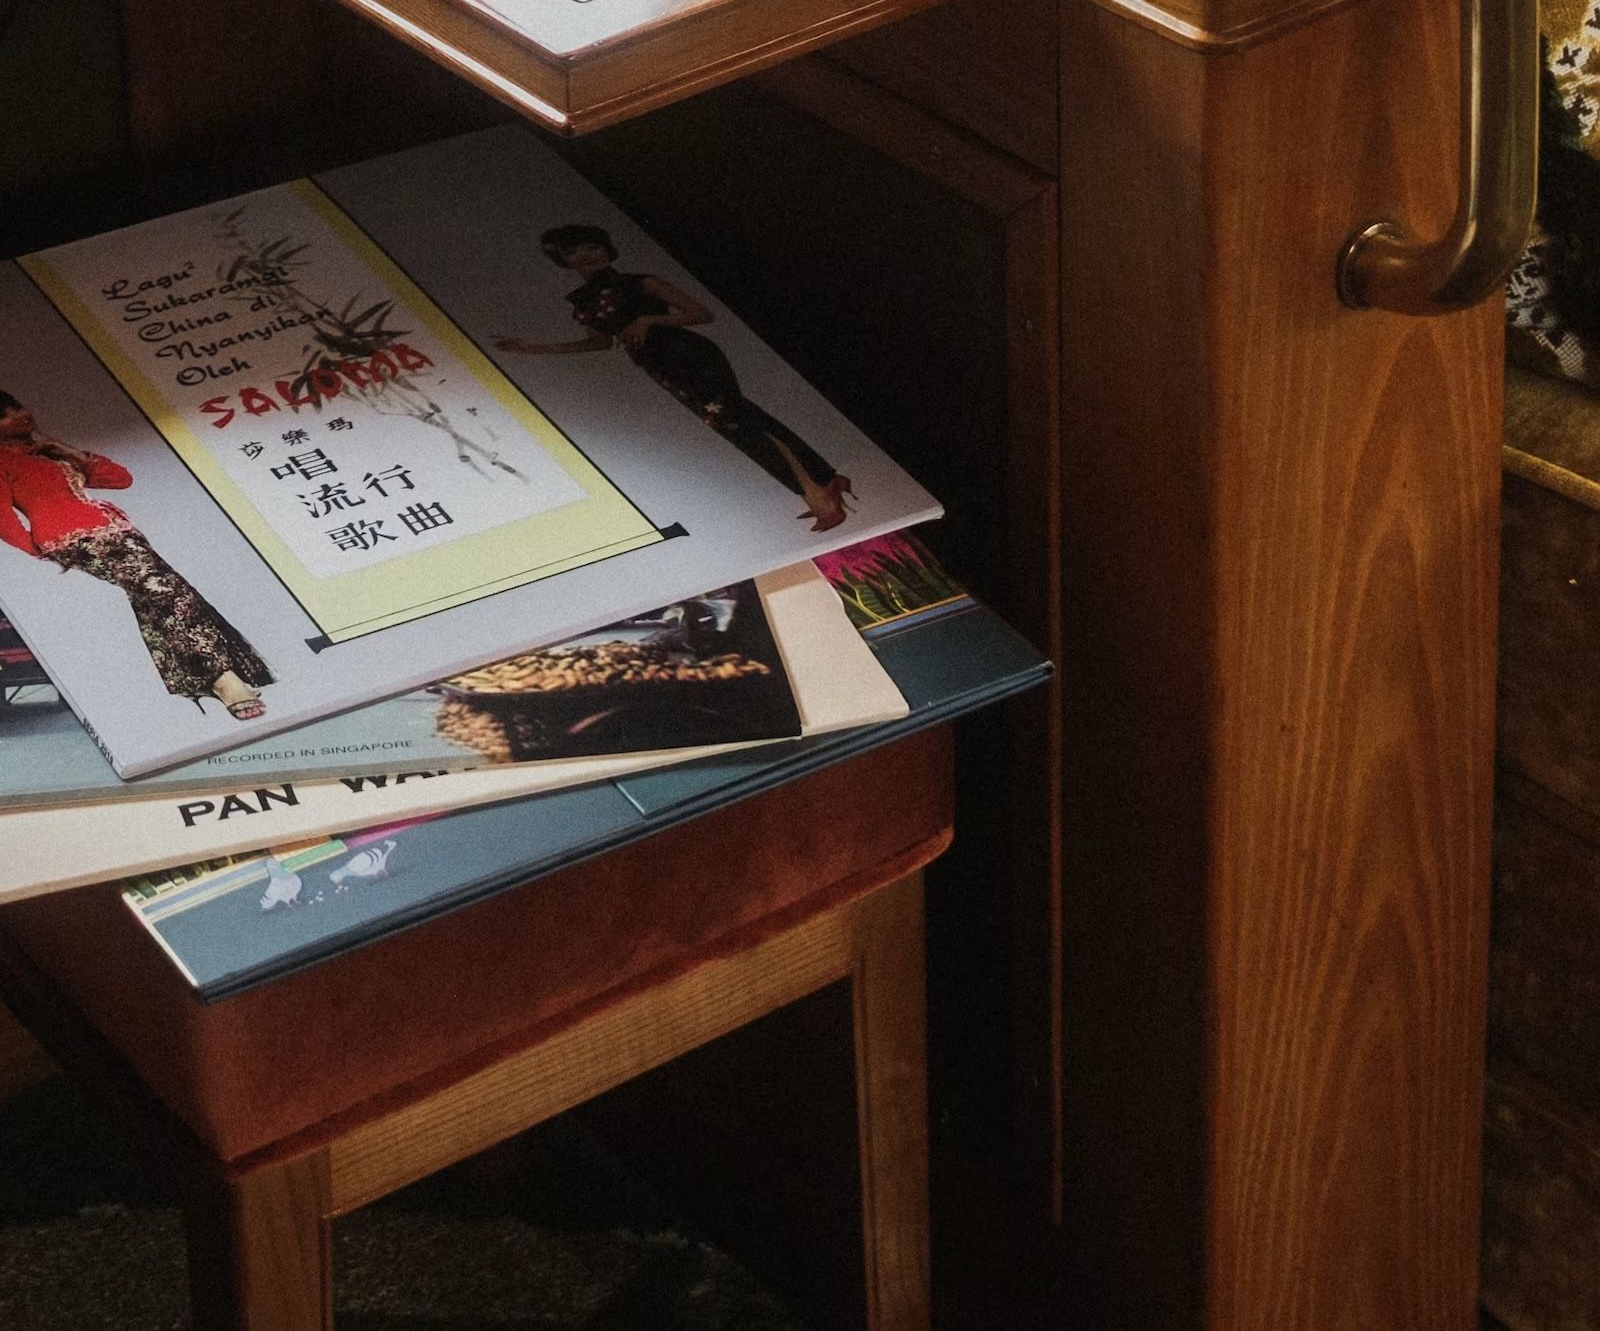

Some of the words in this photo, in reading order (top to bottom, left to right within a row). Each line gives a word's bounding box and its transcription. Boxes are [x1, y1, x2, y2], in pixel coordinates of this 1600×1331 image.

[123, 265, 289, 322] Sukaramai
[138, 310, 233, 342] China
[250, 294, 277, 313] di
[155, 307, 334, 360] Nyanyikan
[176, 357, 252, 386] Oleh
[199, 342, 435, 429] SALOMA
[270, 448, 338, 481] 唱
[295, 464, 416, 518] 流行
[325, 501, 455, 552] 歌曲
[207, 750, 296, 766] RECORDED
[300, 748, 316, 758] IN
[320, 739, 415, 756] SINGAPORE
[178, 783, 301, 828] PAN
